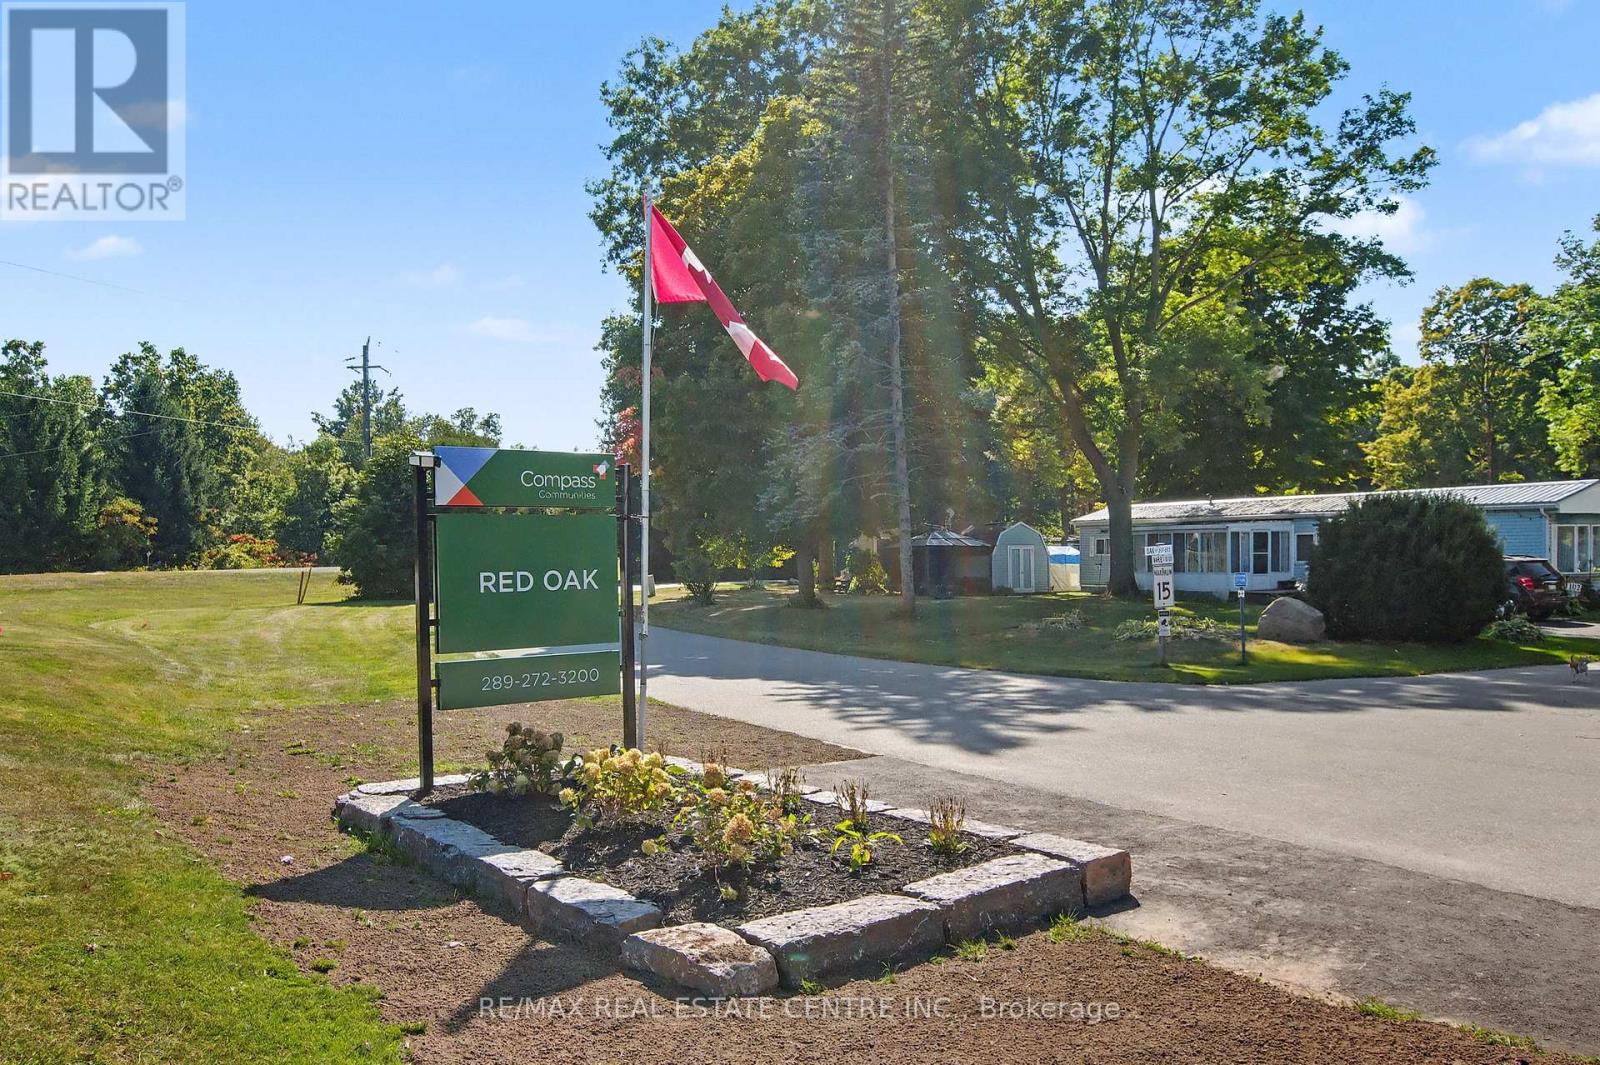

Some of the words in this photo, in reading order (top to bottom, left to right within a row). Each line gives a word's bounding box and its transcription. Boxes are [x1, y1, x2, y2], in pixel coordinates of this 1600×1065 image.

[520, 470, 596, 491] Compass
[538, 489, 596, 500] Communities
[479, 571, 534, 594] RED
[543, 569, 600, 592] OAK
[1156, 581, 1171, 601] 15
[481, 667, 600, 692] 289-272-3200
